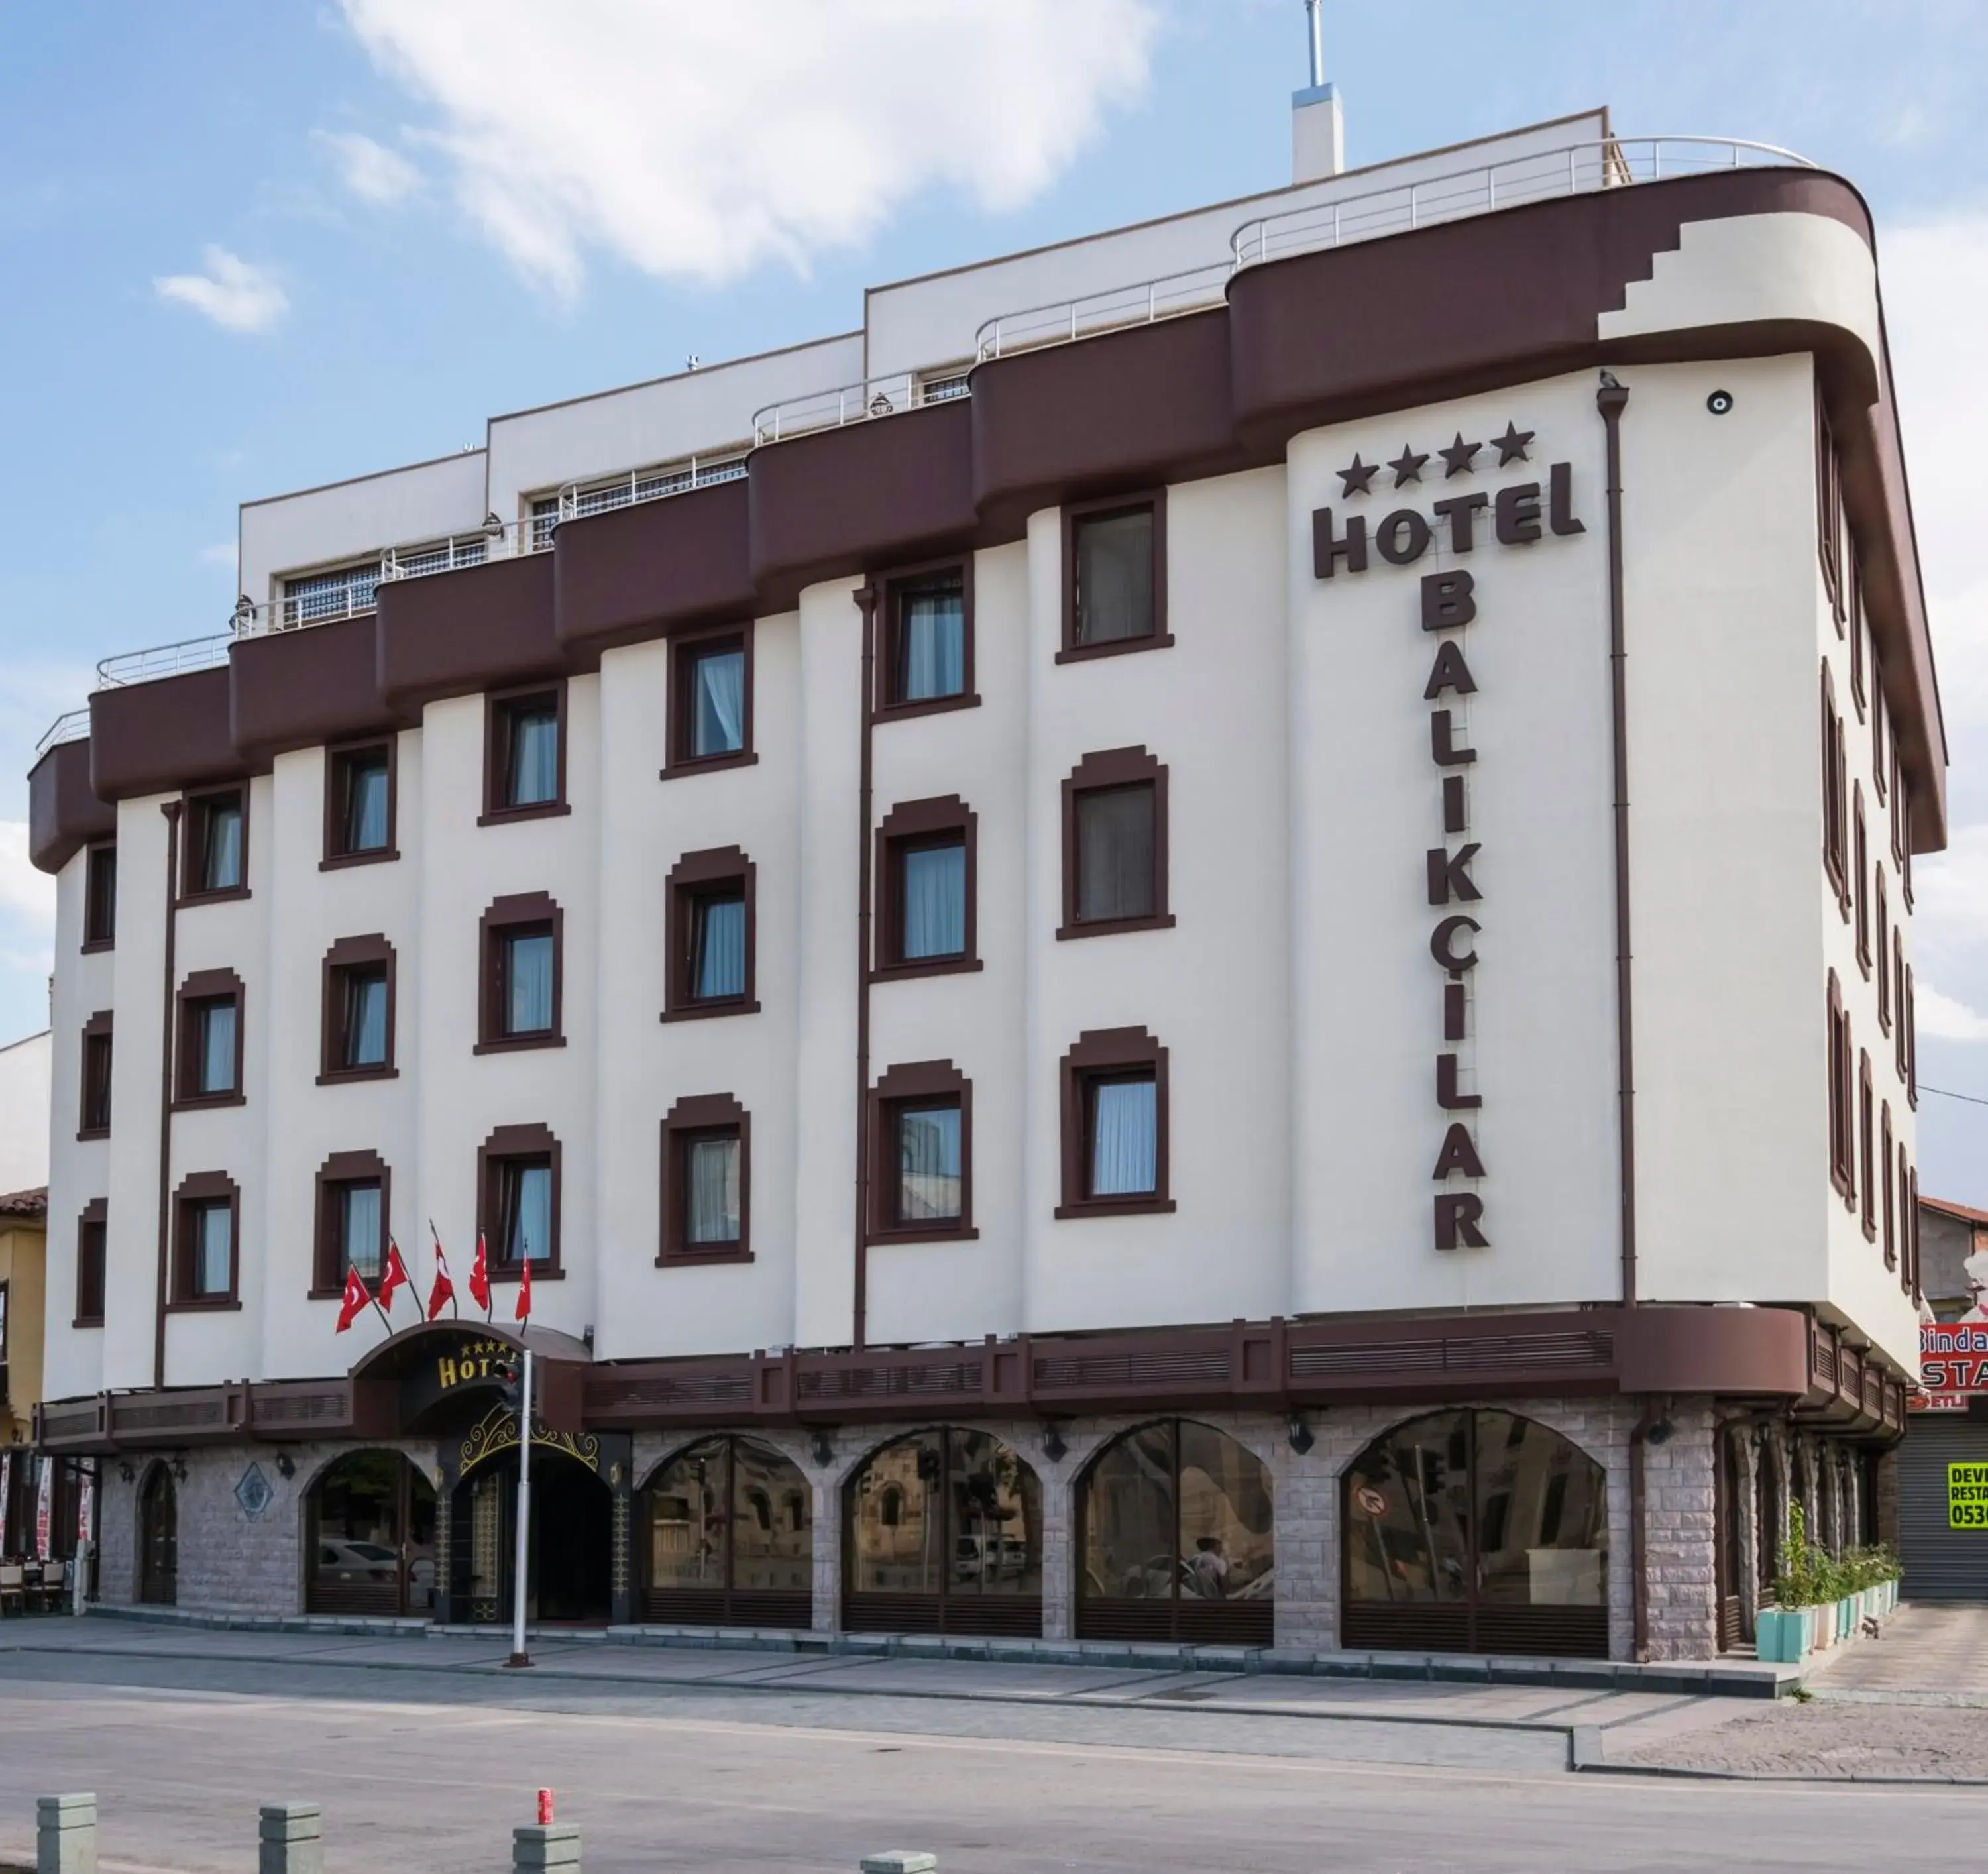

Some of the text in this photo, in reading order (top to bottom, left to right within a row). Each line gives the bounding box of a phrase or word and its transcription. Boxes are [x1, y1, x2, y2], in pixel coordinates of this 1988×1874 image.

[1313, 462, 1587, 579] HOTEL
[439, 1352, 517, 1389] HOT
[1952, 1505, 1988, 1524] 053
